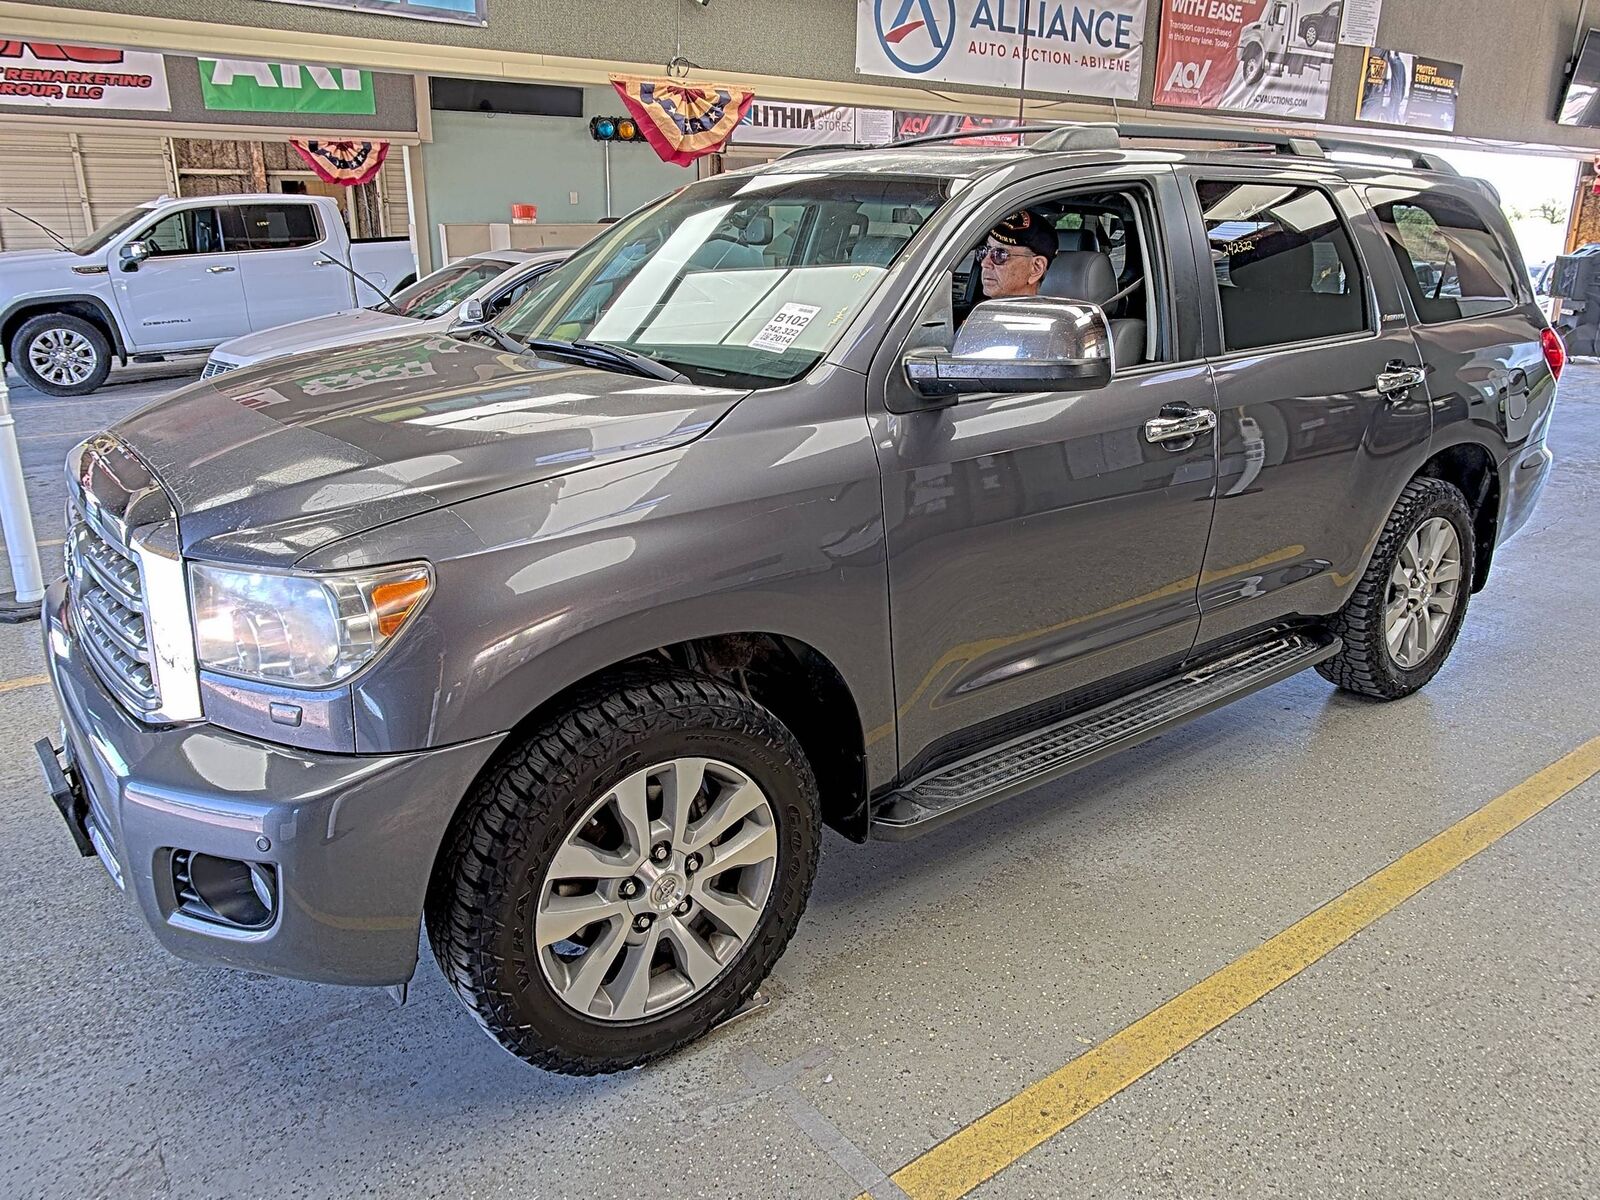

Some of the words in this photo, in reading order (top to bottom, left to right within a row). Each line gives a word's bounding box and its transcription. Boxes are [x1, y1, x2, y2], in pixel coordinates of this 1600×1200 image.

[1172, 0, 1207, 16] WITH
[1208, 1, 1243, 23] EASE.
[970, 0, 1133, 49] ALLIANCE
[1169, 20, 1194, 32] Transport
[1194, 25, 1205, 33] cars
[1206, 27, 1232, 37] purchased
[1174, 33, 1184, 41] this
[1191, 37, 1200, 45] any
[968, 40, 1006, 57] AUTO
[5, 67, 152, 88] REMARKETING
[1164, 59, 1212, 92] ACV
[1416, 64, 1438, 76] PROTECT
[66, 85, 104, 99] LLC
[752, 104, 816, 130] LITHIA
[818, 110, 842, 121] AUTO
[899, 114, 932, 134] ACV
[817, 120, 852, 132] STORES
[1222, 240, 1256, 257] 242322
[143, 318, 191, 327] DENALI
[774, 313, 809, 326] B102
[770, 333, 793, 344] 2014
